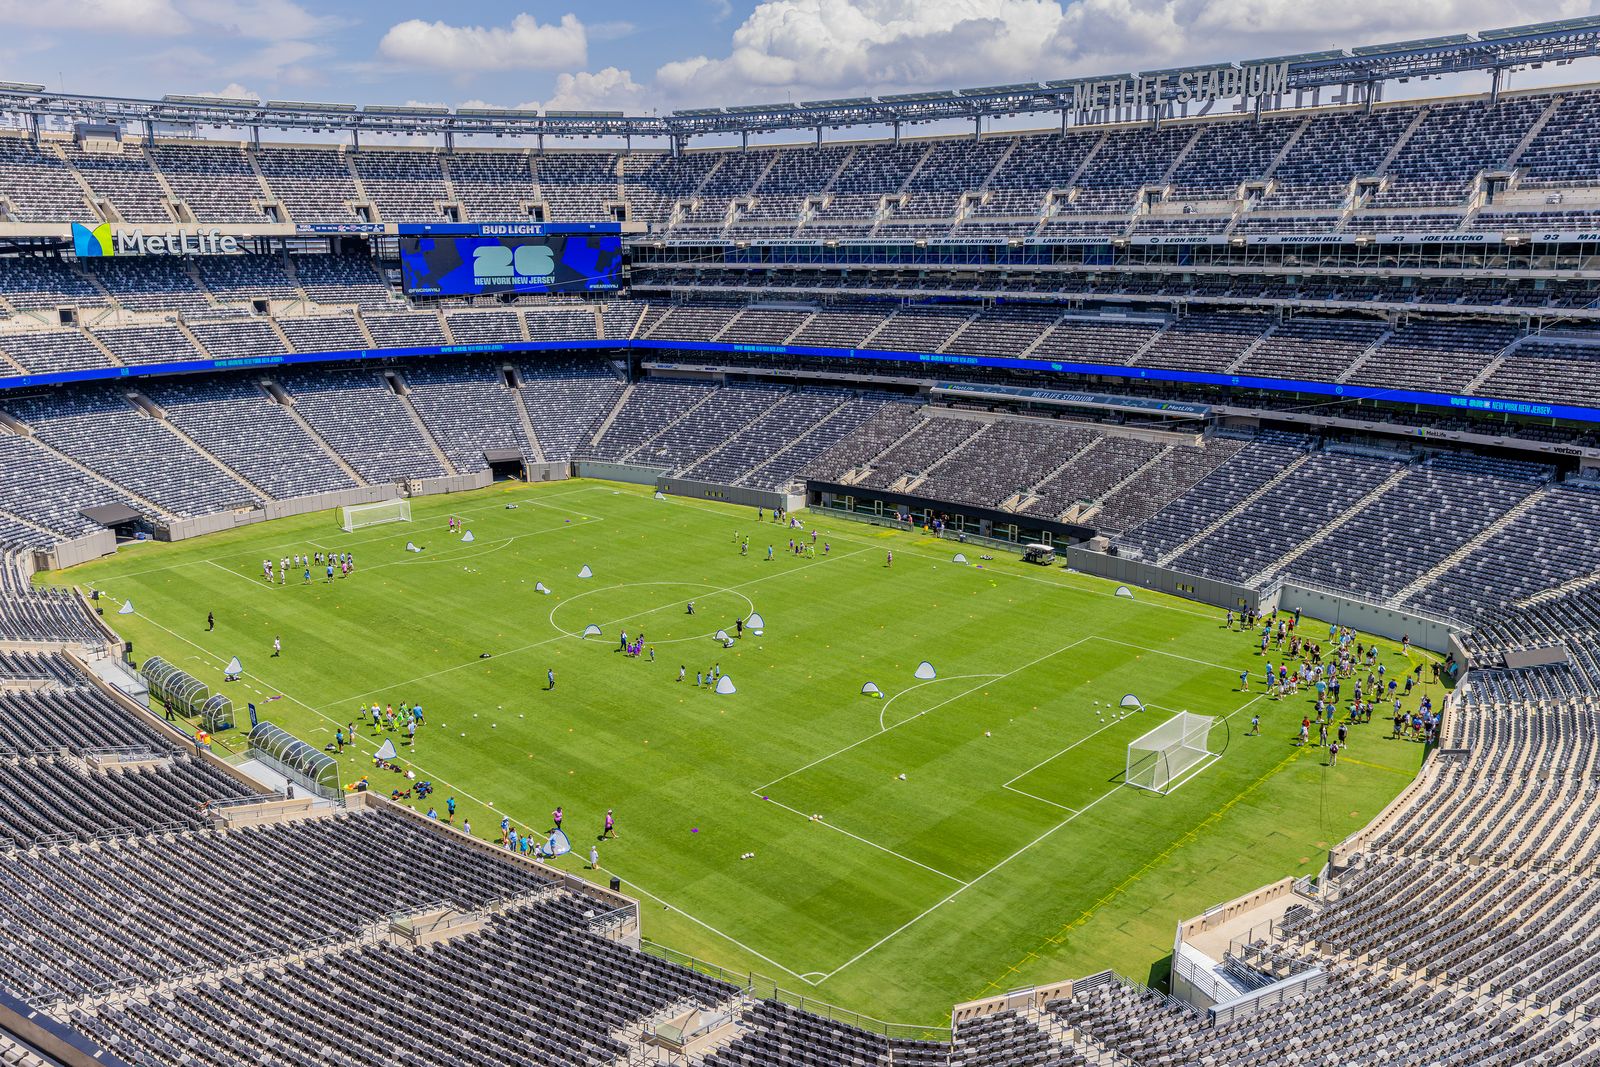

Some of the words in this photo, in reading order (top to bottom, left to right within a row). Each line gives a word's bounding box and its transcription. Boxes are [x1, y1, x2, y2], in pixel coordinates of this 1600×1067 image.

[1073, 75, 1170, 112] METLIFE
[1177, 63, 1289, 103] STADIUM
[482, 225, 507, 234] BUD
[508, 225, 541, 234] LIGHT
[116, 228, 238, 255] MetLife
[473, 246, 555, 277] 26
[474, 277, 491, 286] NEW
[491, 277, 512, 285] YORK
[512, 276, 529, 285] NEW
[529, 276, 555, 284] JERSEY
[1031, 391, 1062, 400] METLIFE
[1061, 394, 1094, 402] STADIUM
[1167, 404, 1195, 412] MetLife
[1492, 401, 1504, 410] NEW
[1504, 403, 1518, 412] YORK
[1518, 404, 1530, 413] NEW
[1530, 405, 1551, 415] JERSEY
[1426, 430, 1447, 438] MetLife
[1553, 446, 1583, 456] verizon
